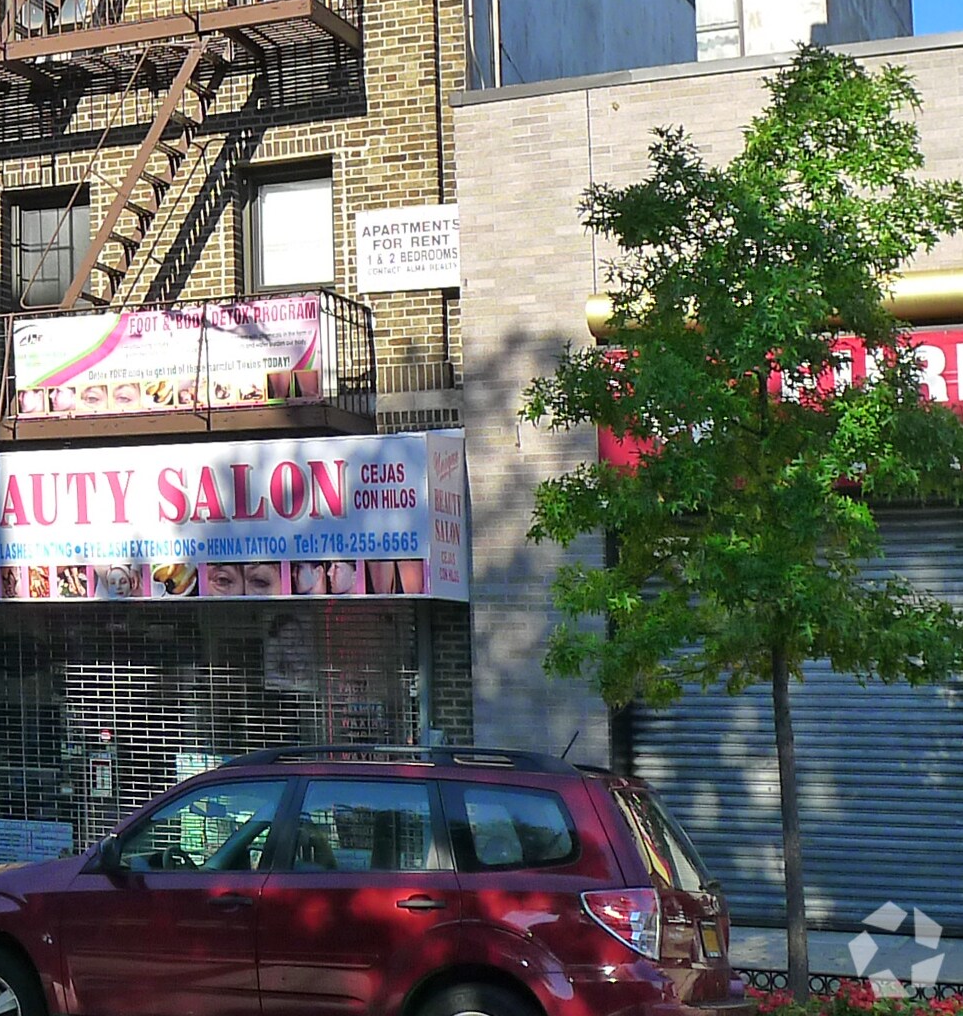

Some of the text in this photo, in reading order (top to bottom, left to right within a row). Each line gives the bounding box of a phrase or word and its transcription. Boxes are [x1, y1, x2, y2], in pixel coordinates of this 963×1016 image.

[362, 219, 460, 237] APARTMENTS
[373, 234, 450, 251] FOR RENT
[367, 247, 458, 265] 1 & 2 BEDROOMS
[129, 315, 157, 334] FOOT
[212, 306, 250, 328] DETOX
[253, 301, 317, 323] PROGRAM
[154, 367, 166, 379] get
[167, 364, 177, 376] rid
[263, 356, 291, 369] TODAY!
[361, 463, 405, 484] CEJAS
[158, 459, 348, 525] SALON
[354, 488, 416, 510] CON HILOS
[434, 488, 461, 517] BEAUTY
[435, 519, 461, 546] SALON
[83, 540, 127, 559] EYELASH
[129, 538, 197, 559] EXTENSIONS
[207, 536, 242, 556] HENNA
[245, 535, 287, 555] TATTOO
[294, 533, 319, 554] Tel:
[321, 530, 419, 554] 718-255-6565
